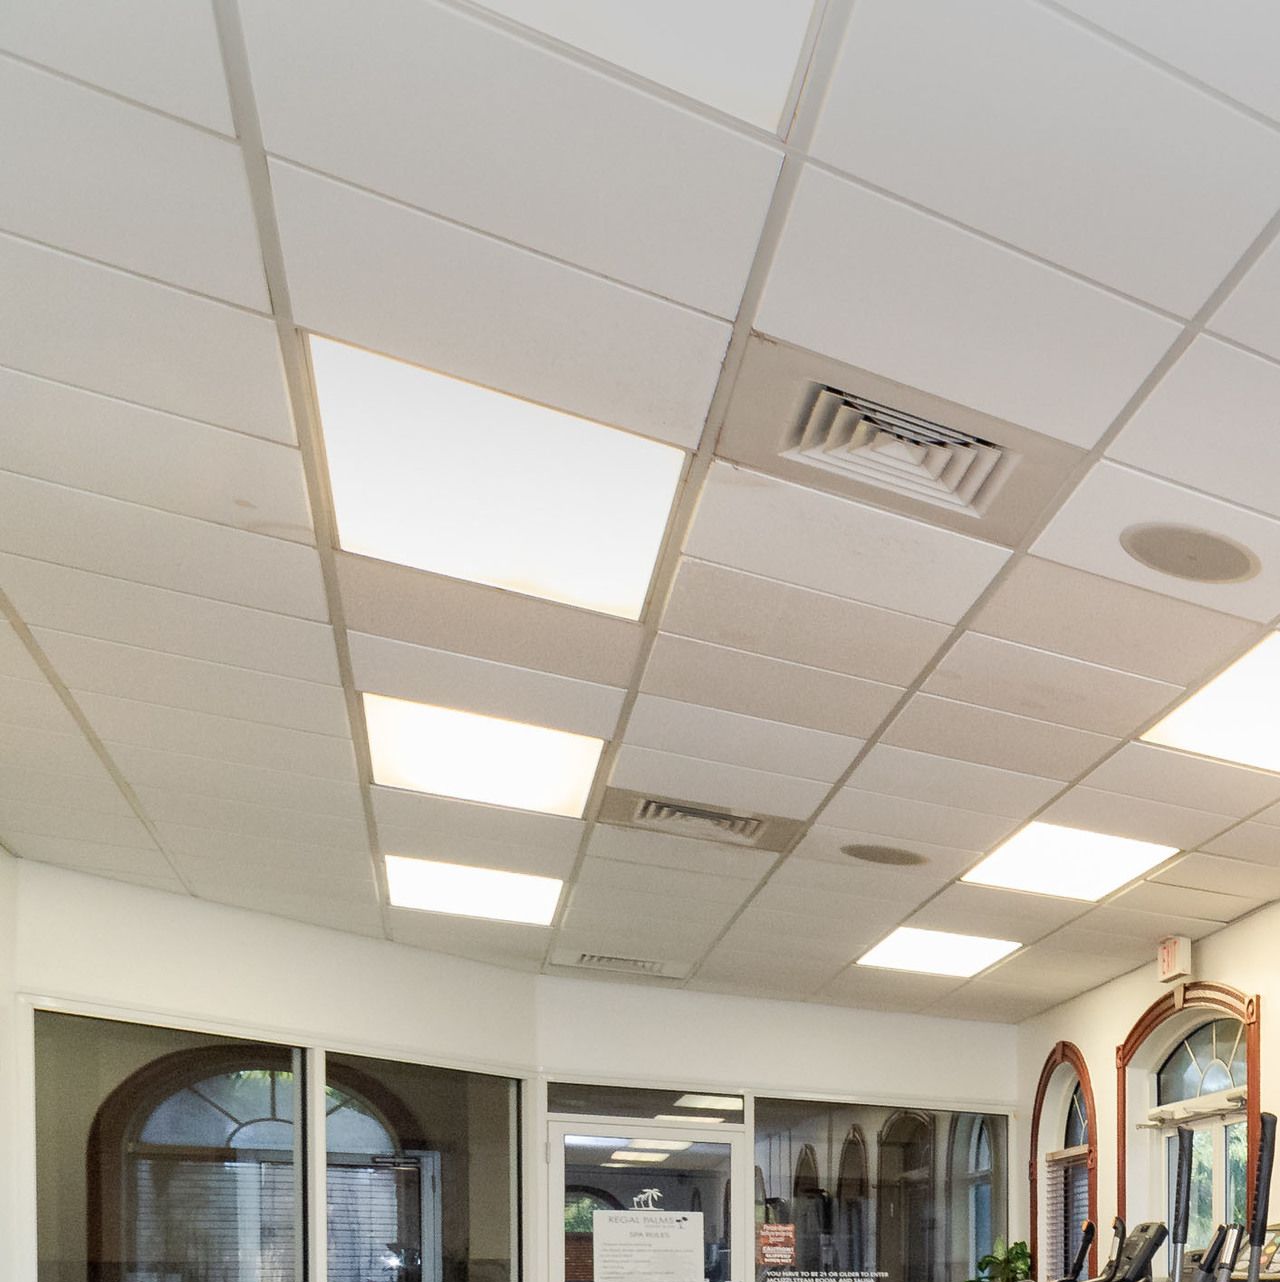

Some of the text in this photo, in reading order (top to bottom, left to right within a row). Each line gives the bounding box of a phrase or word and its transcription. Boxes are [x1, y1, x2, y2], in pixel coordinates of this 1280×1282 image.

[608, 1216, 675, 1225] REGAL PALMS
[629, 1231, 671, 1239] SPA RULES
